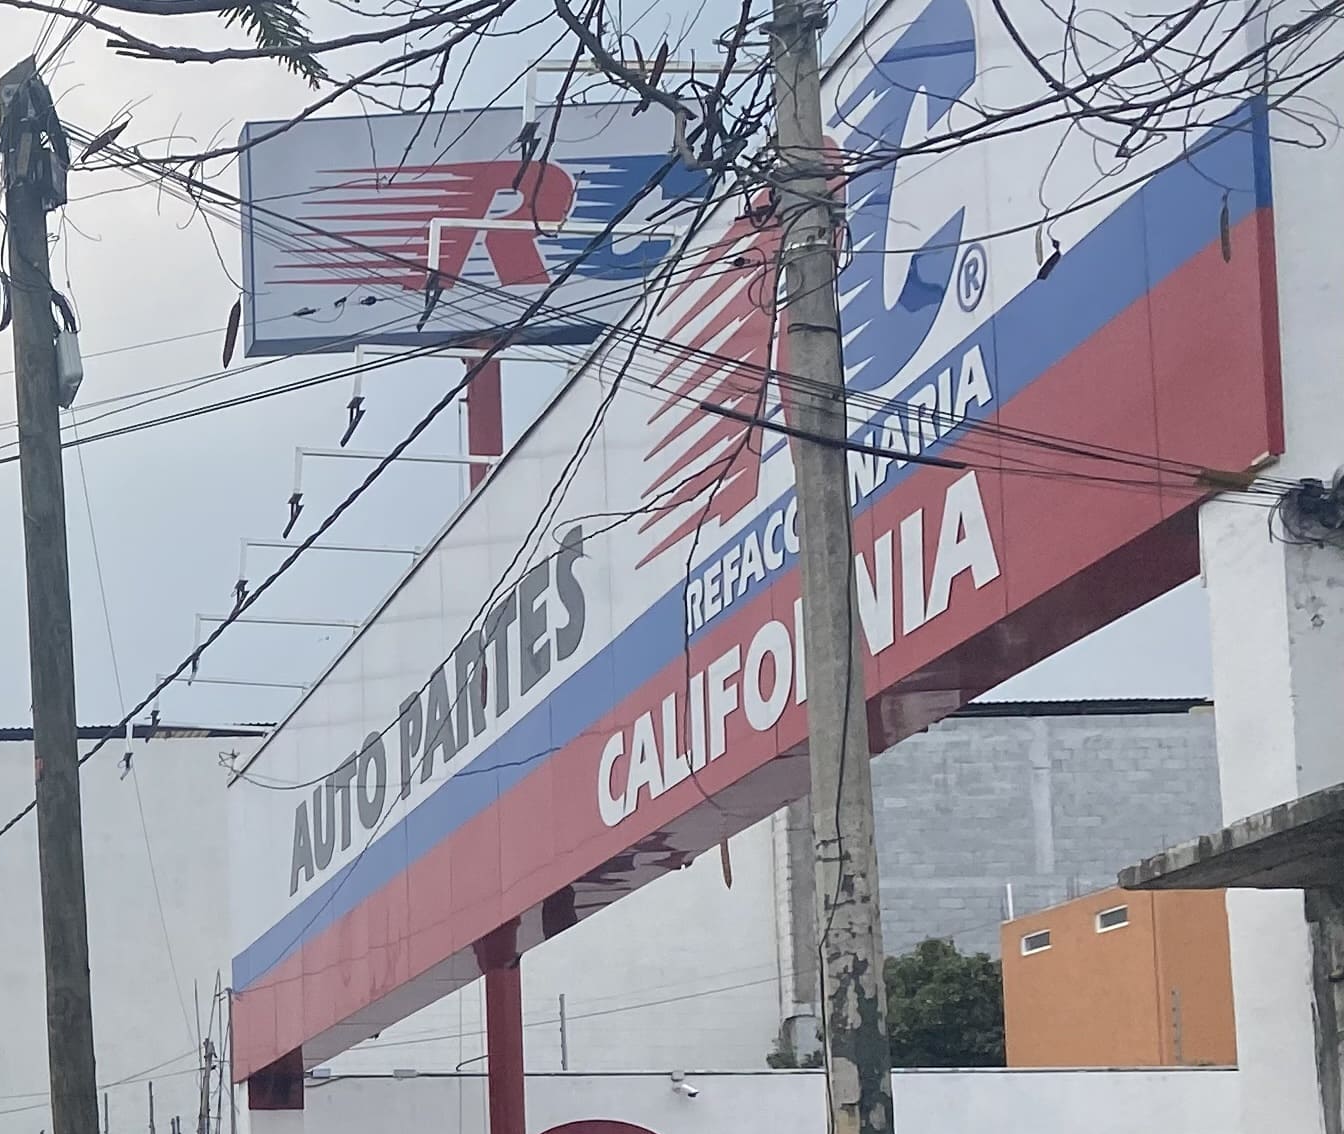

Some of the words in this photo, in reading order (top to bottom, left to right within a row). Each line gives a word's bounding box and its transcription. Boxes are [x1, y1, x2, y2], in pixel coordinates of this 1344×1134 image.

[687, 344, 994, 637] REFACCNARIA
[290, 731, 387, 897] AUTO
[398, 524, 586, 800] PARTES
